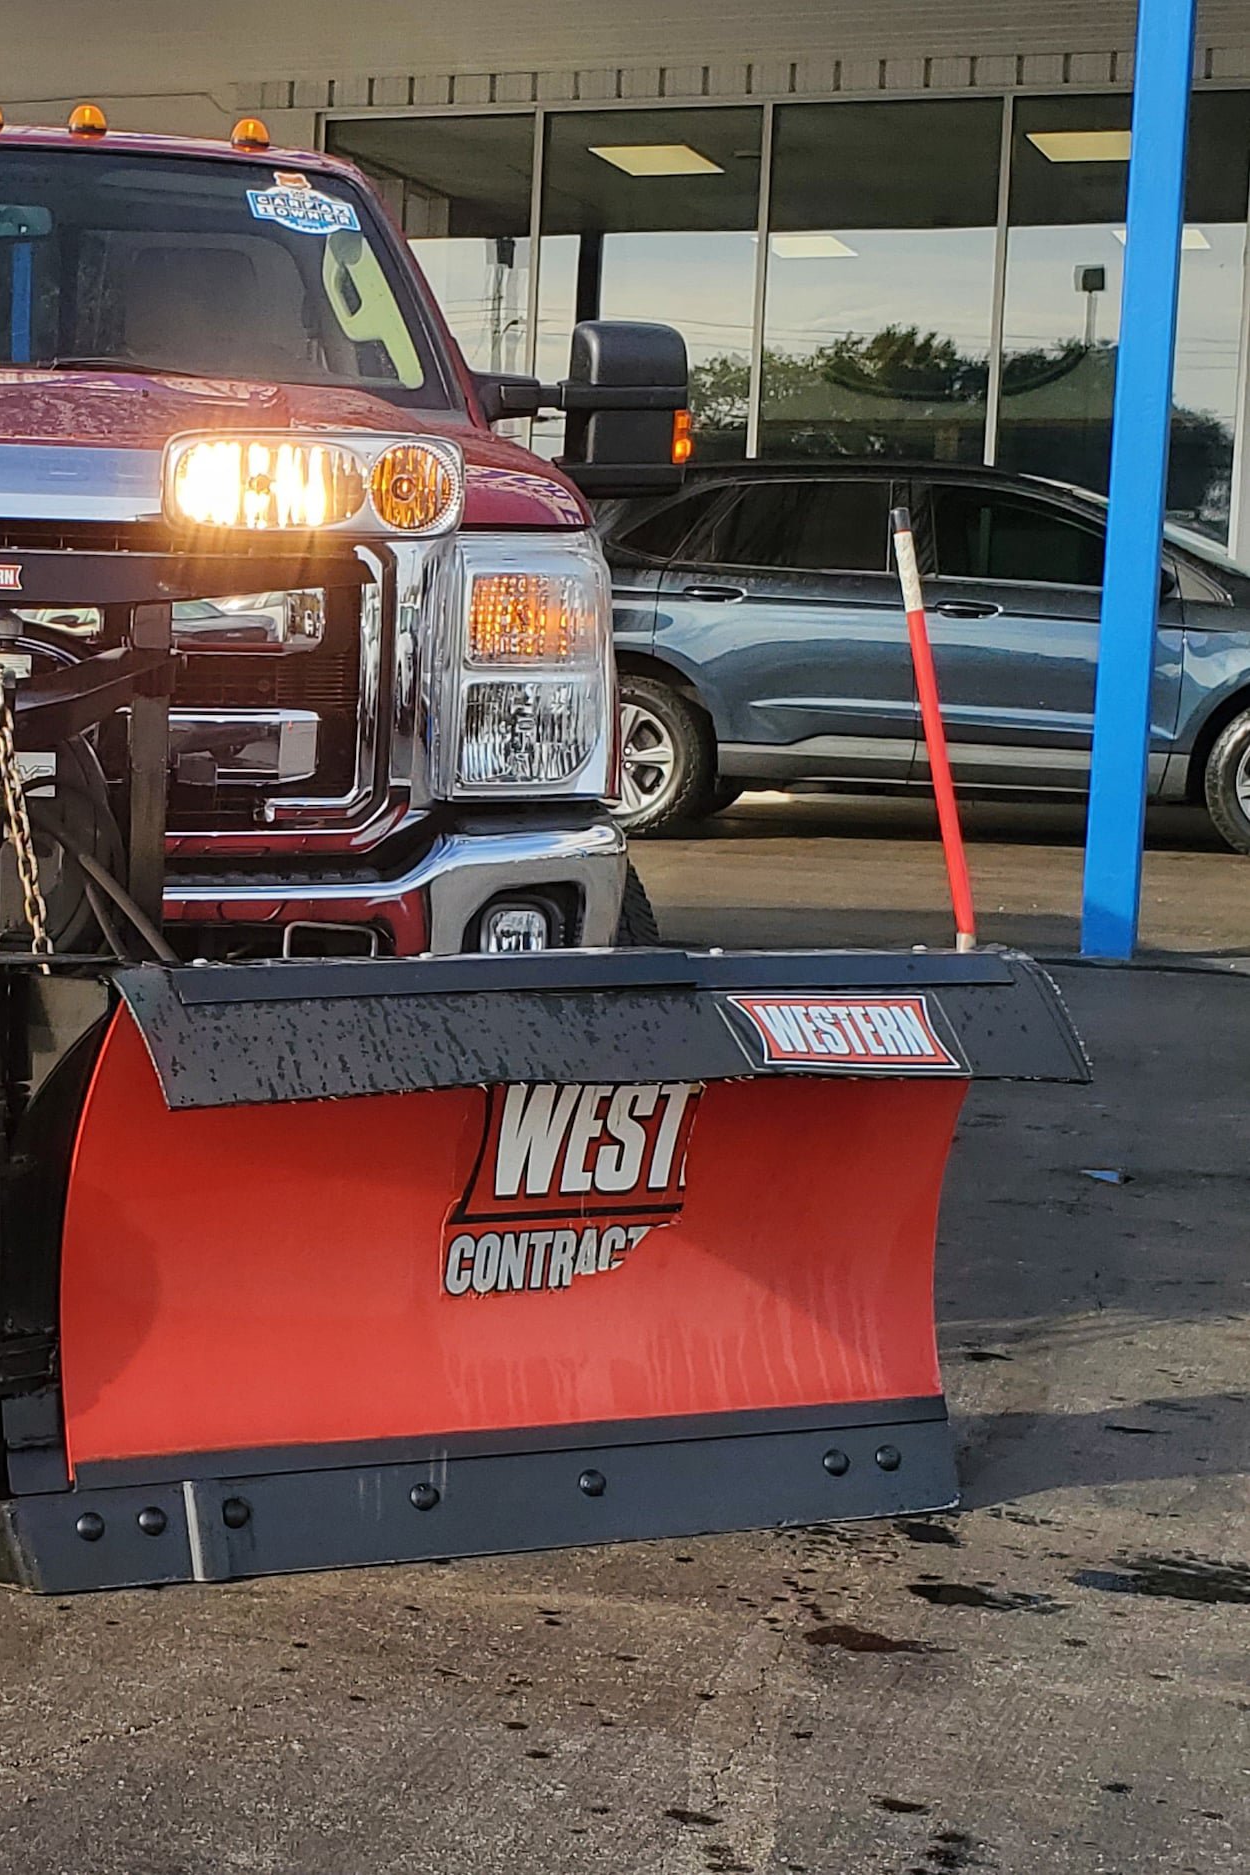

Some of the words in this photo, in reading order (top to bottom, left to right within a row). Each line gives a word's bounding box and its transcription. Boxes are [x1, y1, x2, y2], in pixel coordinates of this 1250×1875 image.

[256, 196, 347, 216] CARFAX
[752, 1005, 936, 1056] WESTERN
[494, 1083, 702, 1197] WEST
